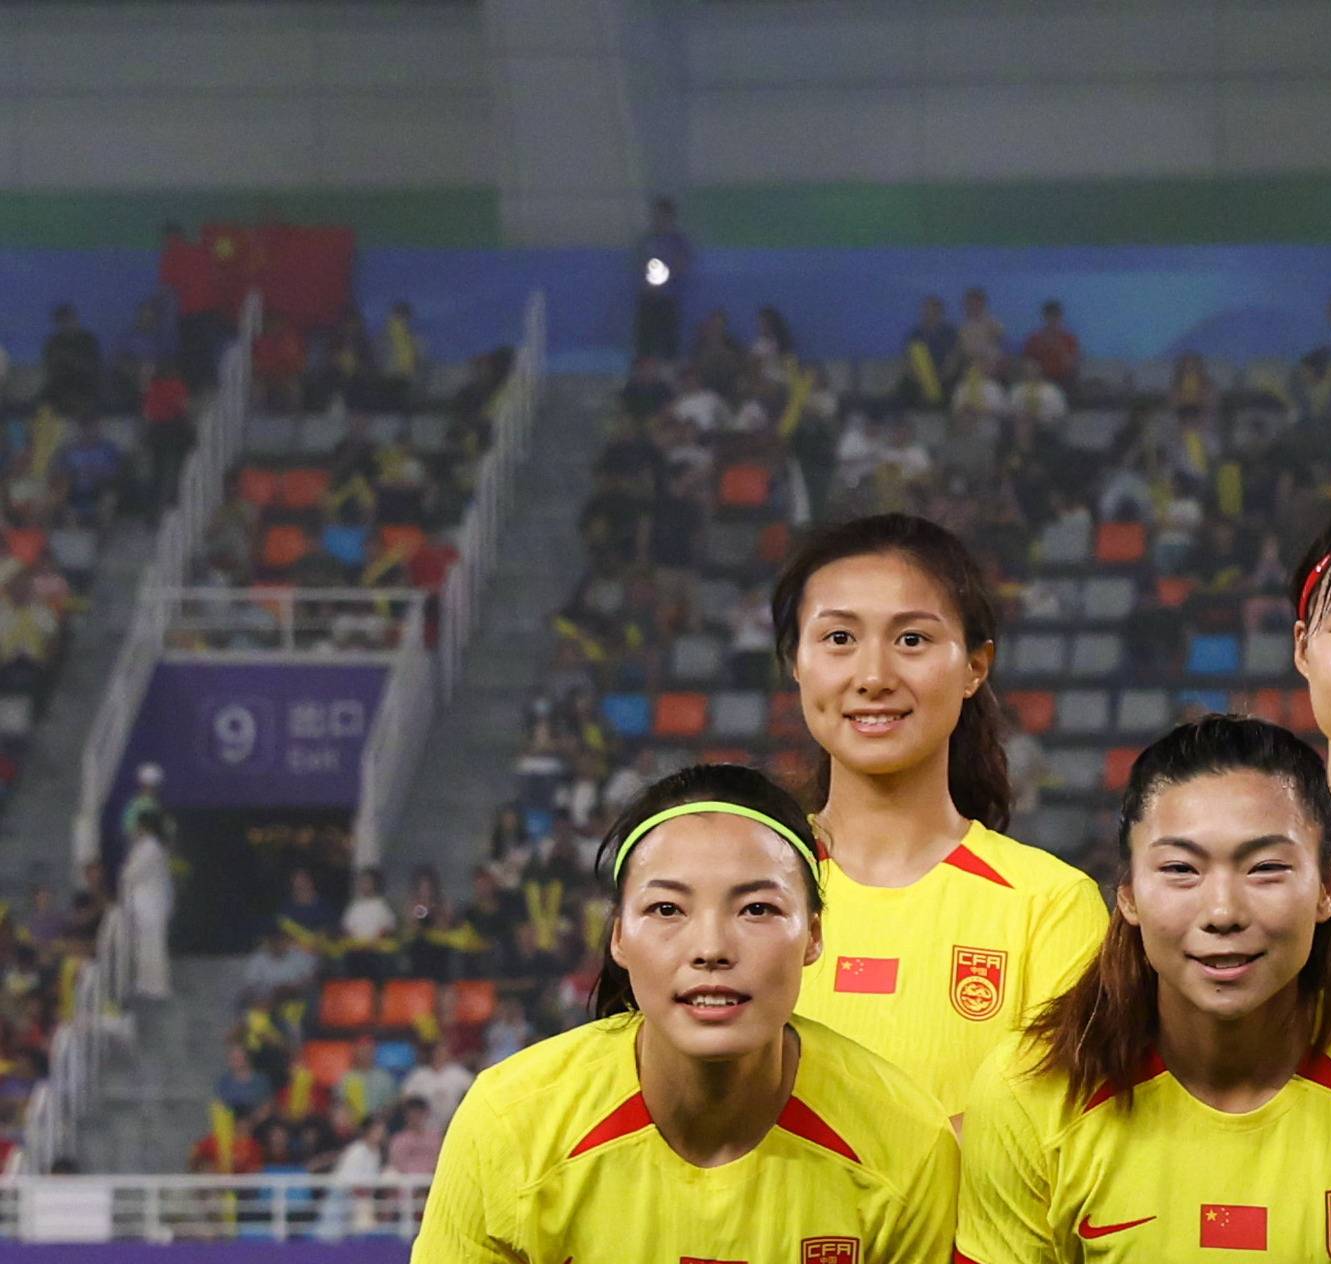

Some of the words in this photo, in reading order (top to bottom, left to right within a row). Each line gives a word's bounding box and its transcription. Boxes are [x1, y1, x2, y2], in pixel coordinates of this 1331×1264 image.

[214, 703, 256, 766] 9
[958, 952, 1001, 970] CFA
[807, 1243, 852, 1258] CFA
